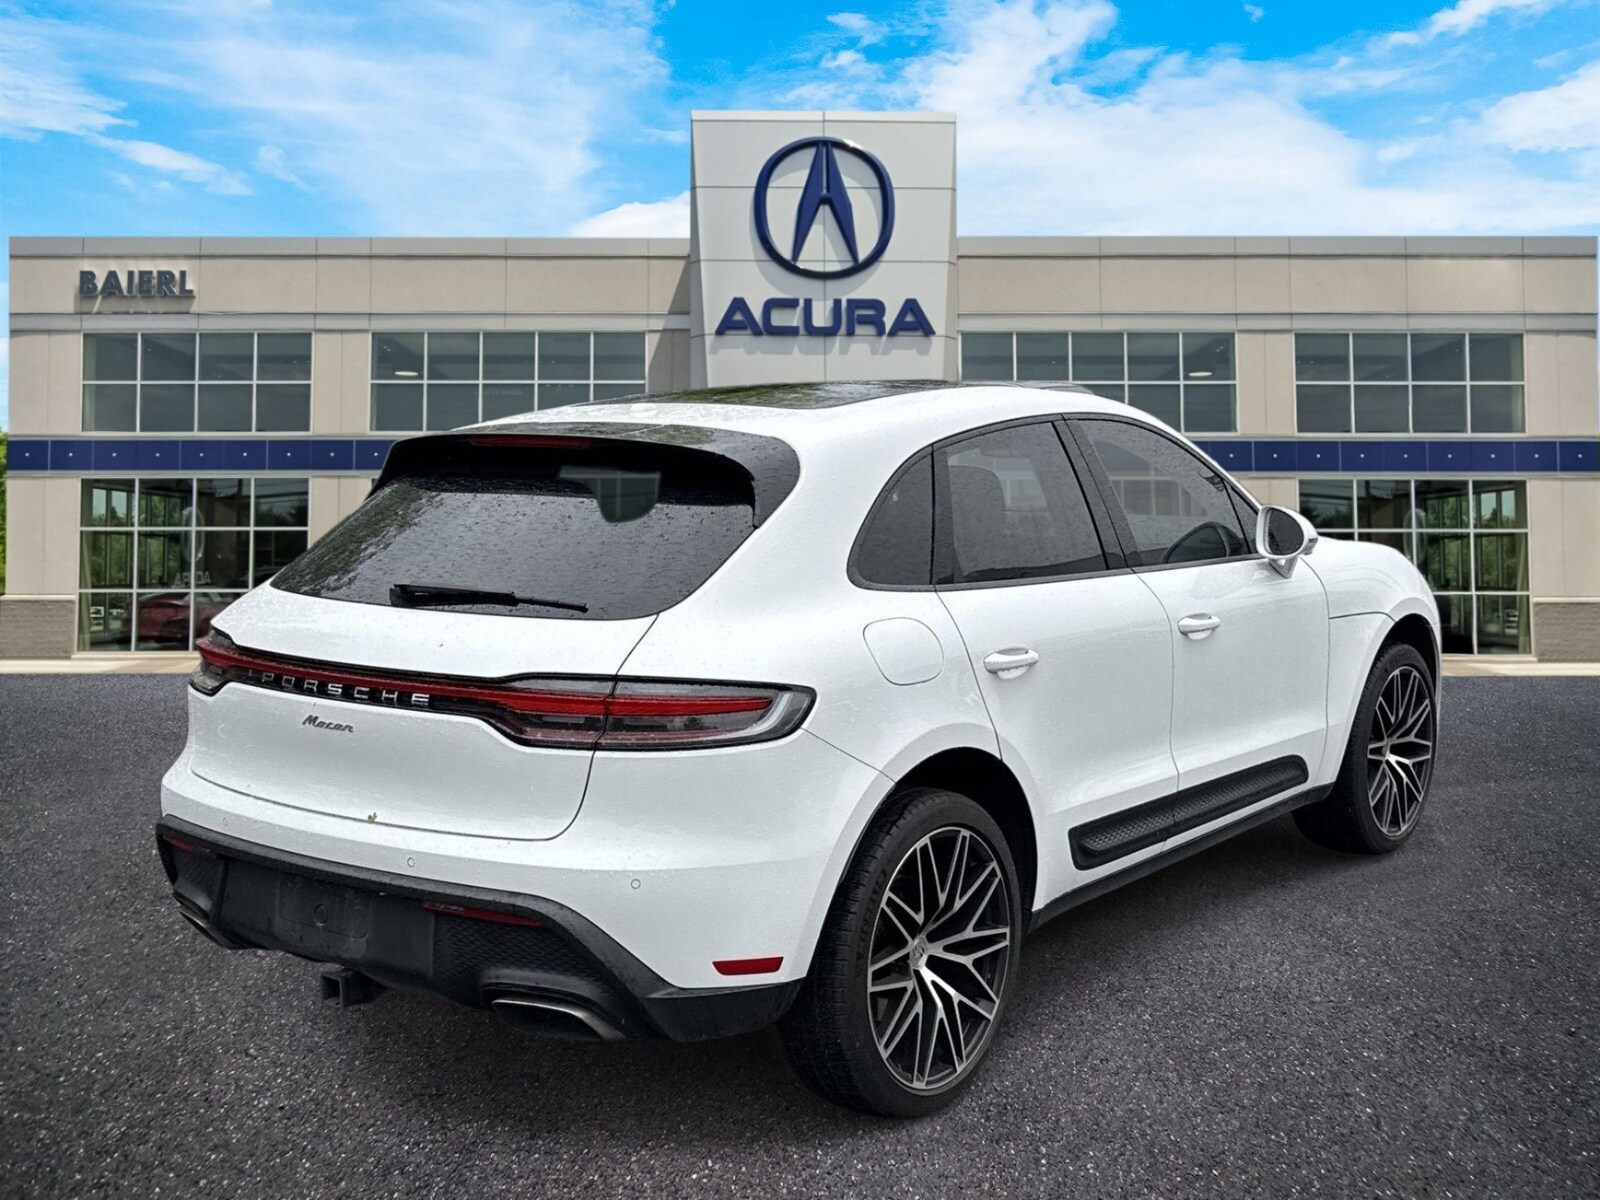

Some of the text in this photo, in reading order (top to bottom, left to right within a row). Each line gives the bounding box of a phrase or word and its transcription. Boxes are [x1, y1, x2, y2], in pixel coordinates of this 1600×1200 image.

[79, 270, 195, 297] BAIERL
[715, 297, 936, 337] ACURA
[262, 672, 430, 704] PORSCHE
[302, 714, 354, 733] Macan
